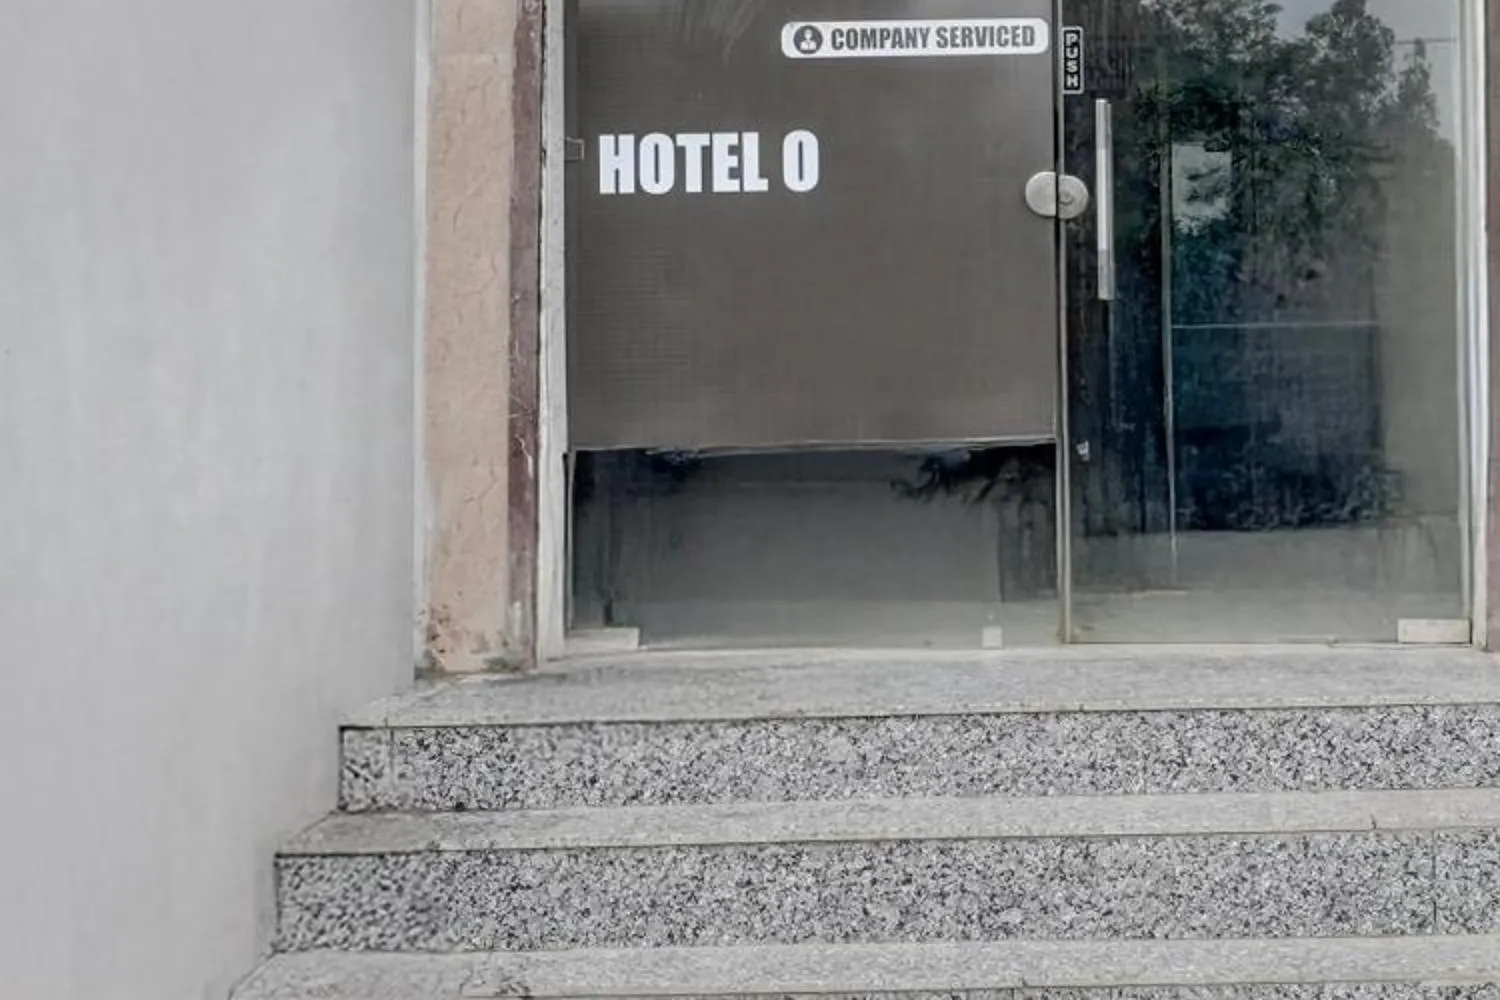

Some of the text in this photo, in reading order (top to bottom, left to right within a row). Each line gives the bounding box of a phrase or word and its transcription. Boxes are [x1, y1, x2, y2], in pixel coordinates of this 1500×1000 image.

[831, 24, 1035, 51] COMPANY SERVICED
[1065, 33, 1079, 88] PUSH
[599, 129, 819, 195] HOTEL O
